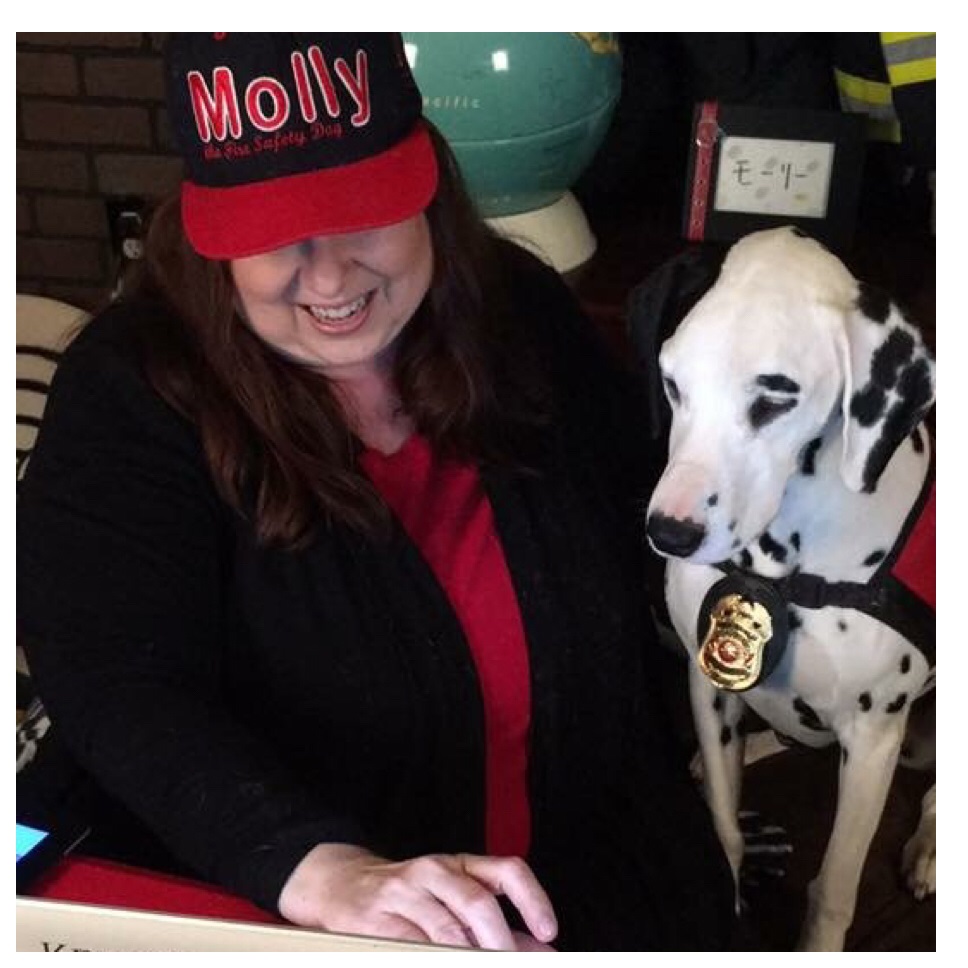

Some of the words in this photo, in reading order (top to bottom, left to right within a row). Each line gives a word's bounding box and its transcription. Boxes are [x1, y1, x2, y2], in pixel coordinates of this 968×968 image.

[188, 46, 370, 142] Molly
[251, 129, 306, 153] Safety
[309, 120, 344, 140] Dog
